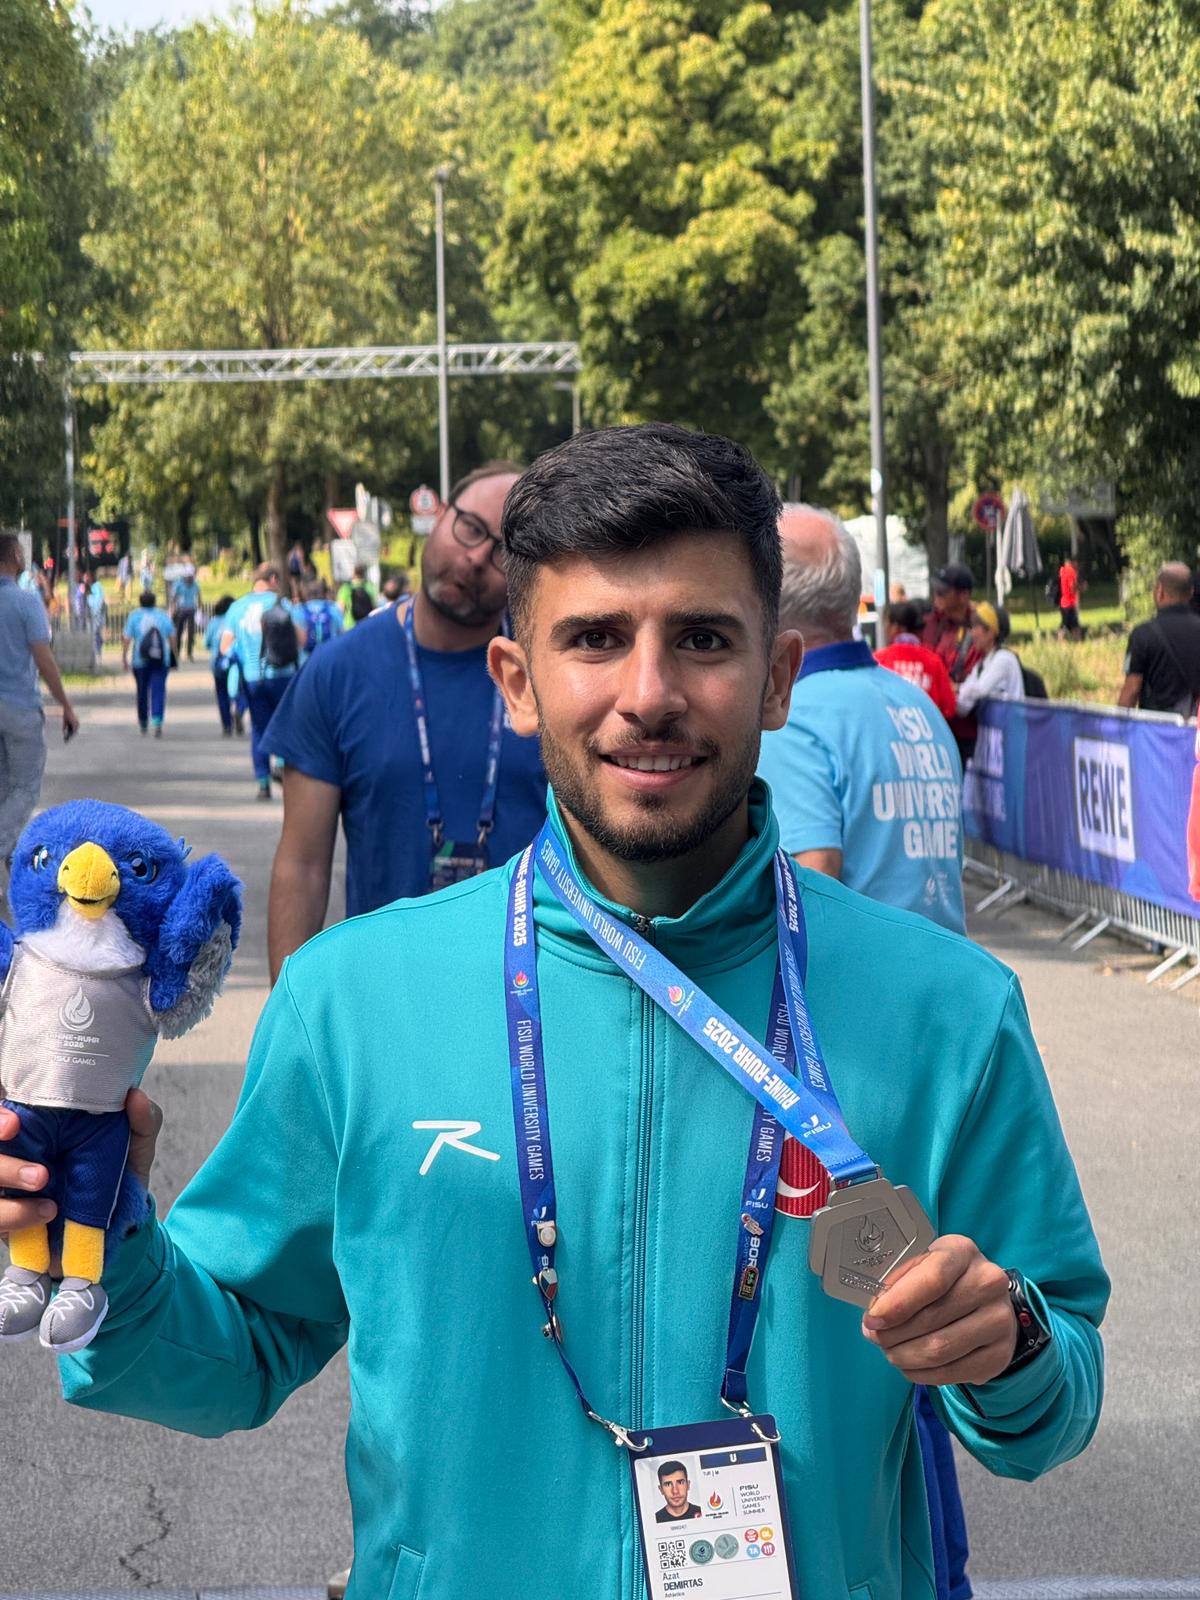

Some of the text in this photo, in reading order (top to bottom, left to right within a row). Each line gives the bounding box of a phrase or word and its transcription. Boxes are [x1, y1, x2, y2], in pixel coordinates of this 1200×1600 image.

[1078, 759, 1129, 840] REWE
[541, 839, 647, 971] FISU WORLD UNIVERSITY GAMES
[788, 900, 799, 933] 2025
[513, 914, 527, 947] 2025
[50, 1032, 100, 1044] HINE-RUHR
[772, 1003, 790, 1063] FISU WORLD
[72, 1057, 97, 1066] GAMES
[702, 1016, 801, 1111] RHINE-RUHR 2025
[517, 1019, 545, 1180] FISU WORLD UNIVERSITY GAMES
[803, 1121, 832, 1138] FISU
[756, 1126, 775, 1163] GAMES
[745, 1200, 769, 1209] FISU
[729, 1453, 737, 1462] U
[741, 1495, 771, 1504] UNIVERSITY
[742, 1502, 761, 1510] GAMES
[662, 1572, 680, 1581] Azat
[663, 1578, 704, 1592] DEMIRTAS
